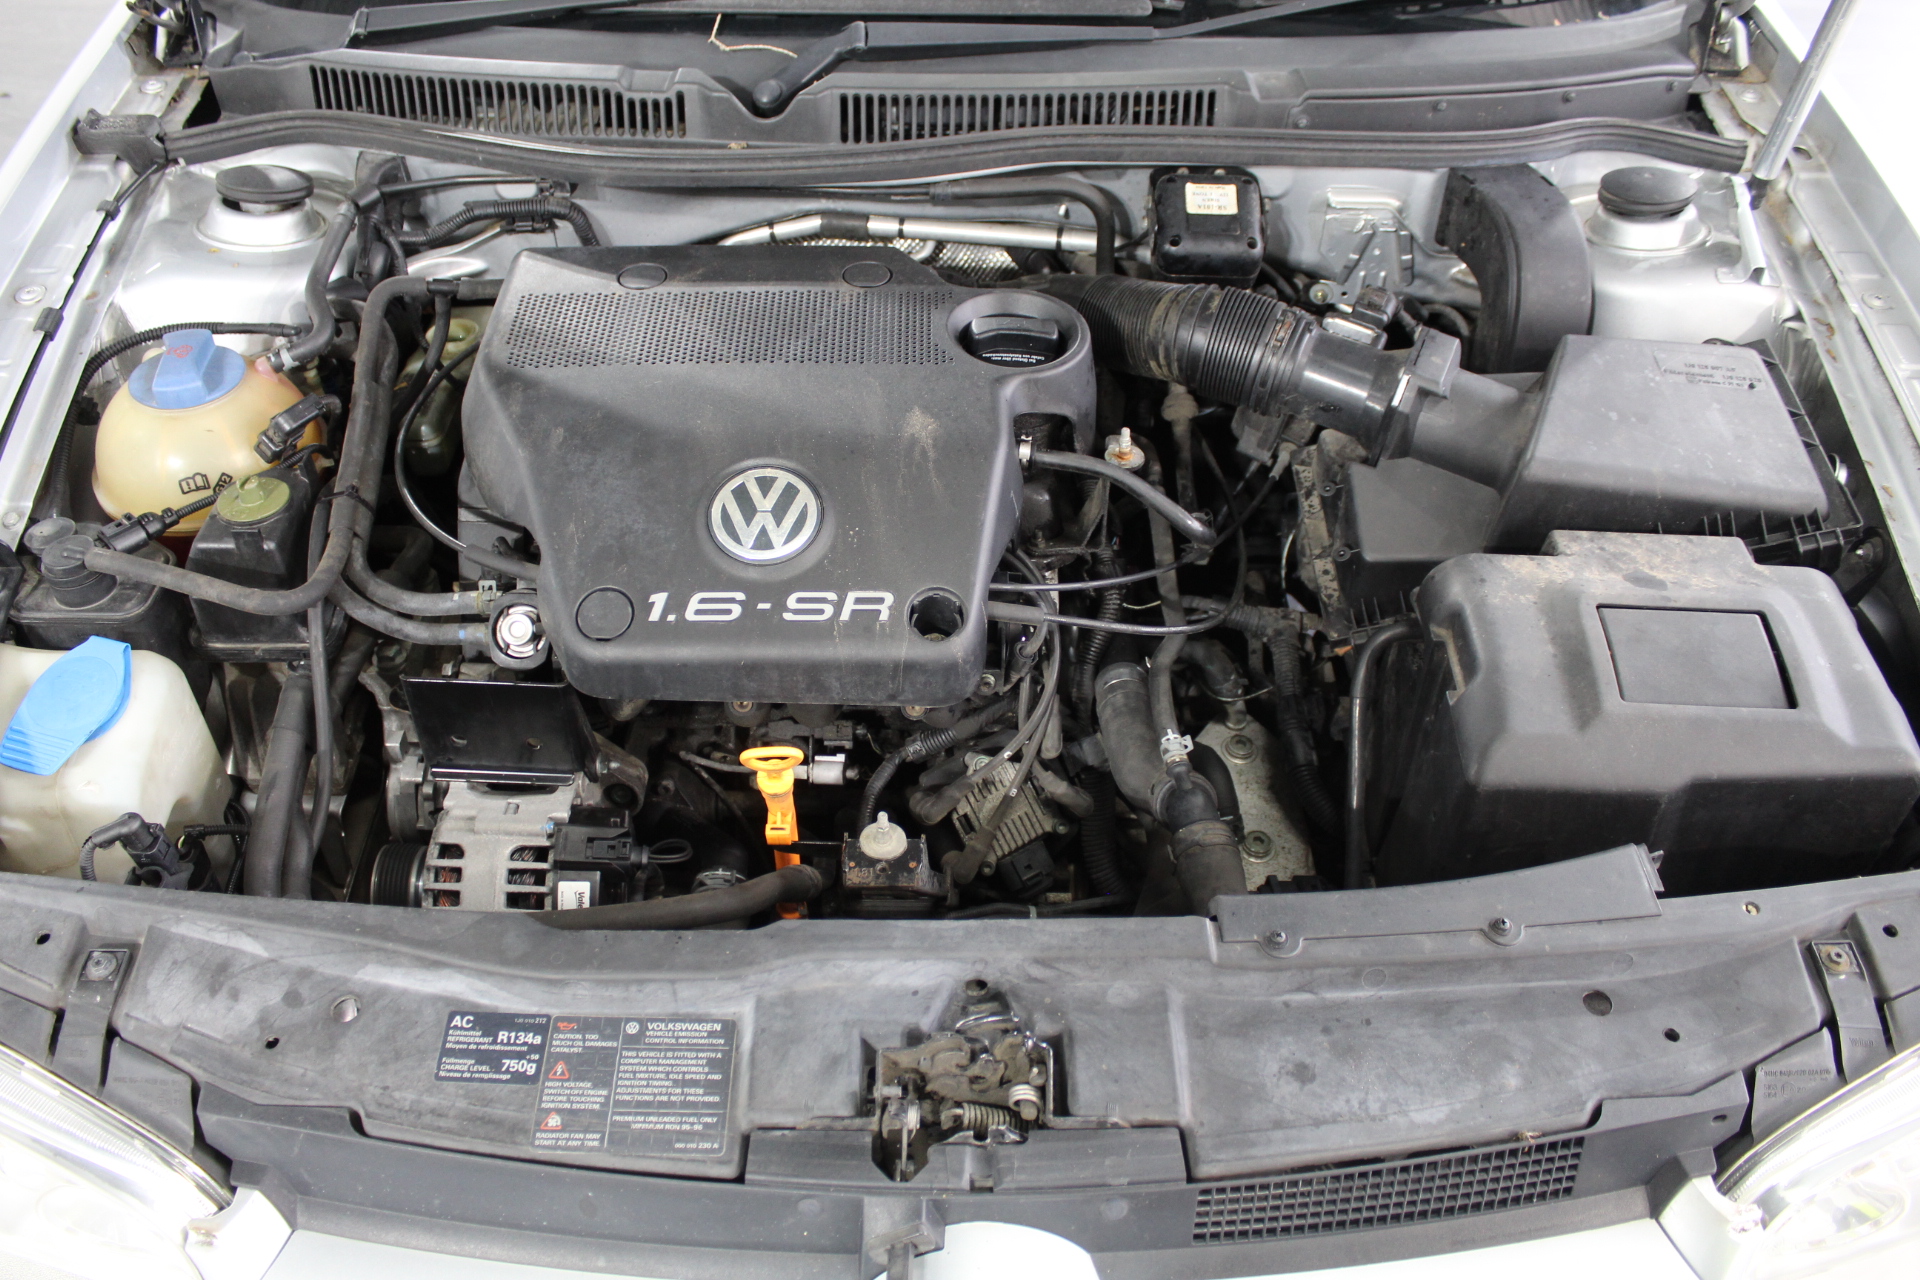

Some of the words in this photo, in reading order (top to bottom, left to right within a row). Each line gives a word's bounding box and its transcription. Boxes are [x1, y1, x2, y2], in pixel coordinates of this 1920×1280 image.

[450, 1016, 474, 1028] AC
[647, 1022, 722, 1031] VOLKSWAGEN
[497, 1031, 542, 1045] R134a
[501, 1059, 537, 1075] 750g
